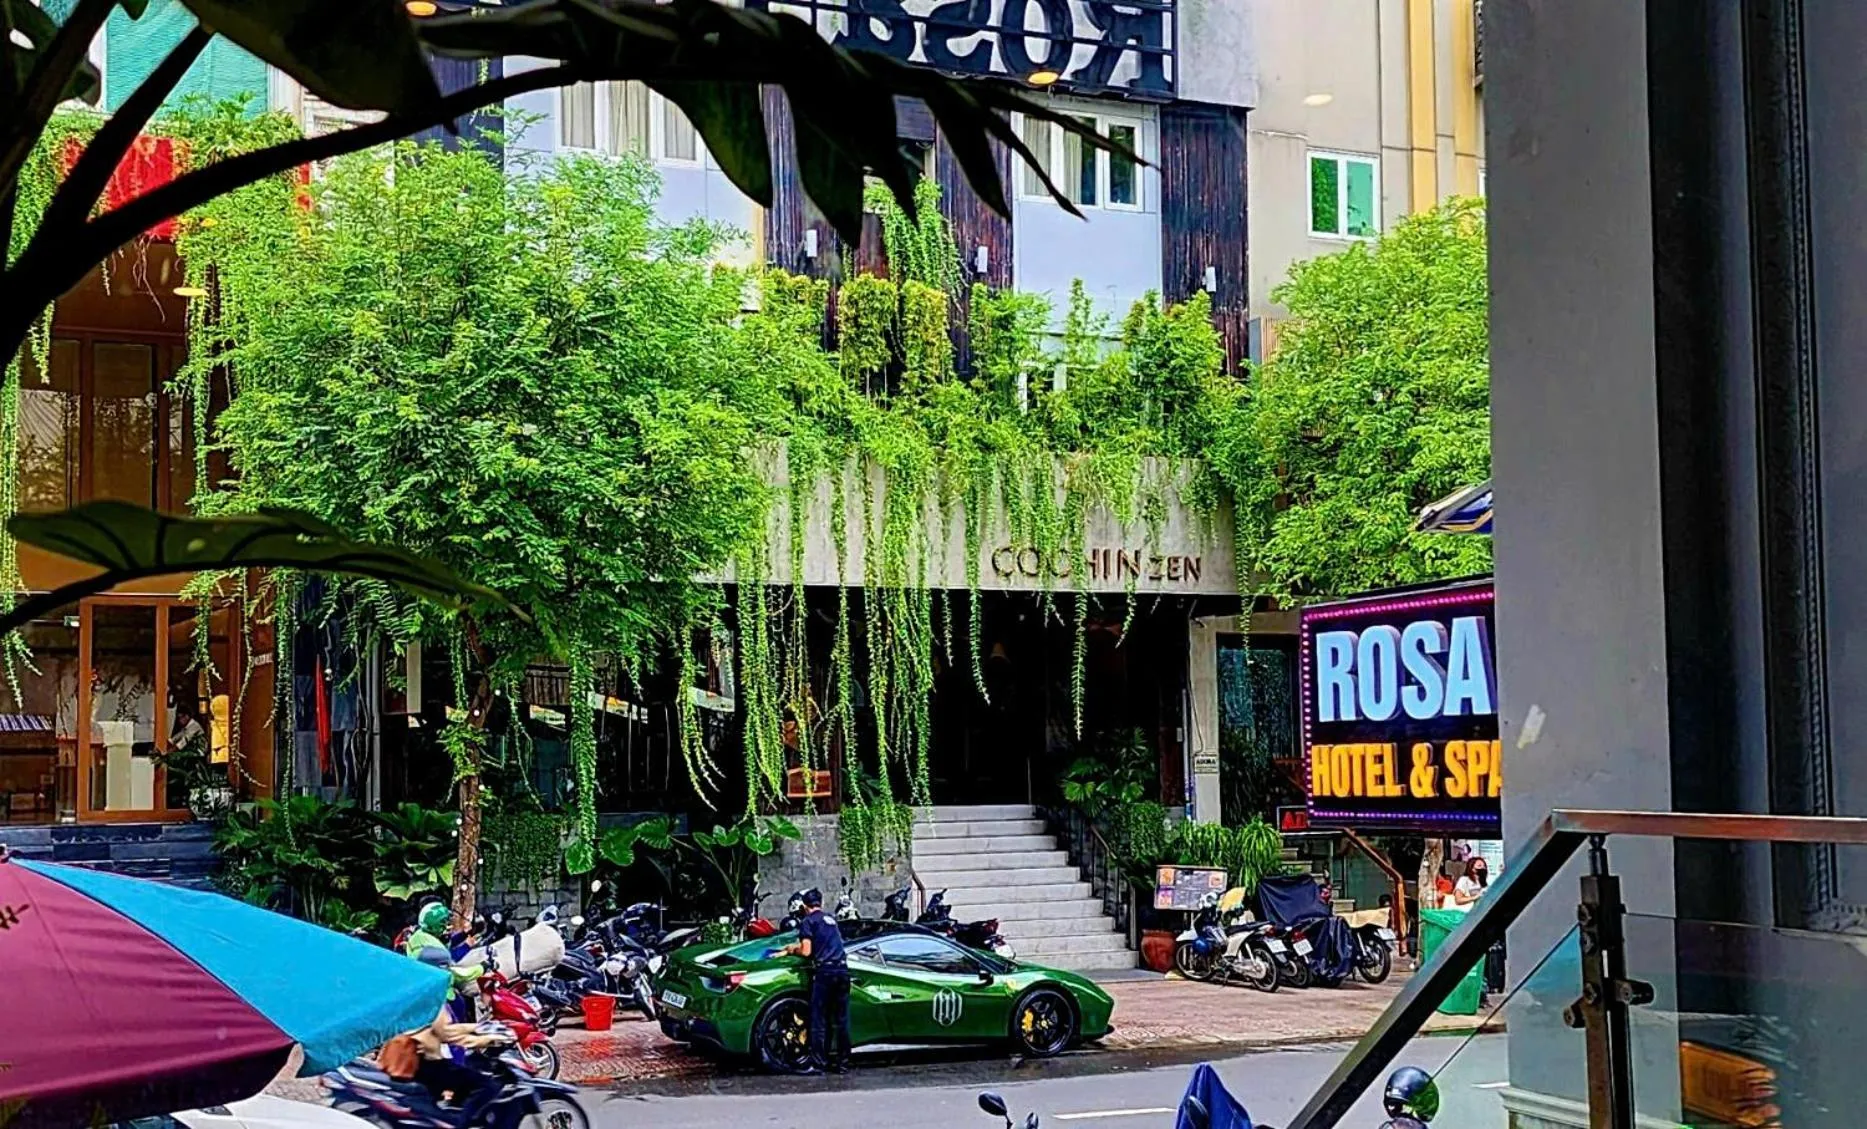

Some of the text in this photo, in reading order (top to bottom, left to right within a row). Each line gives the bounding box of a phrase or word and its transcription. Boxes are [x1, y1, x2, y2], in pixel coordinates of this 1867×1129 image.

[1148, 555, 1201, 582] ZEN
[1316, 616, 1497, 722] ROSA
[1311, 743, 1405, 797] HOTEL
[1409, 742, 1438, 798] &
